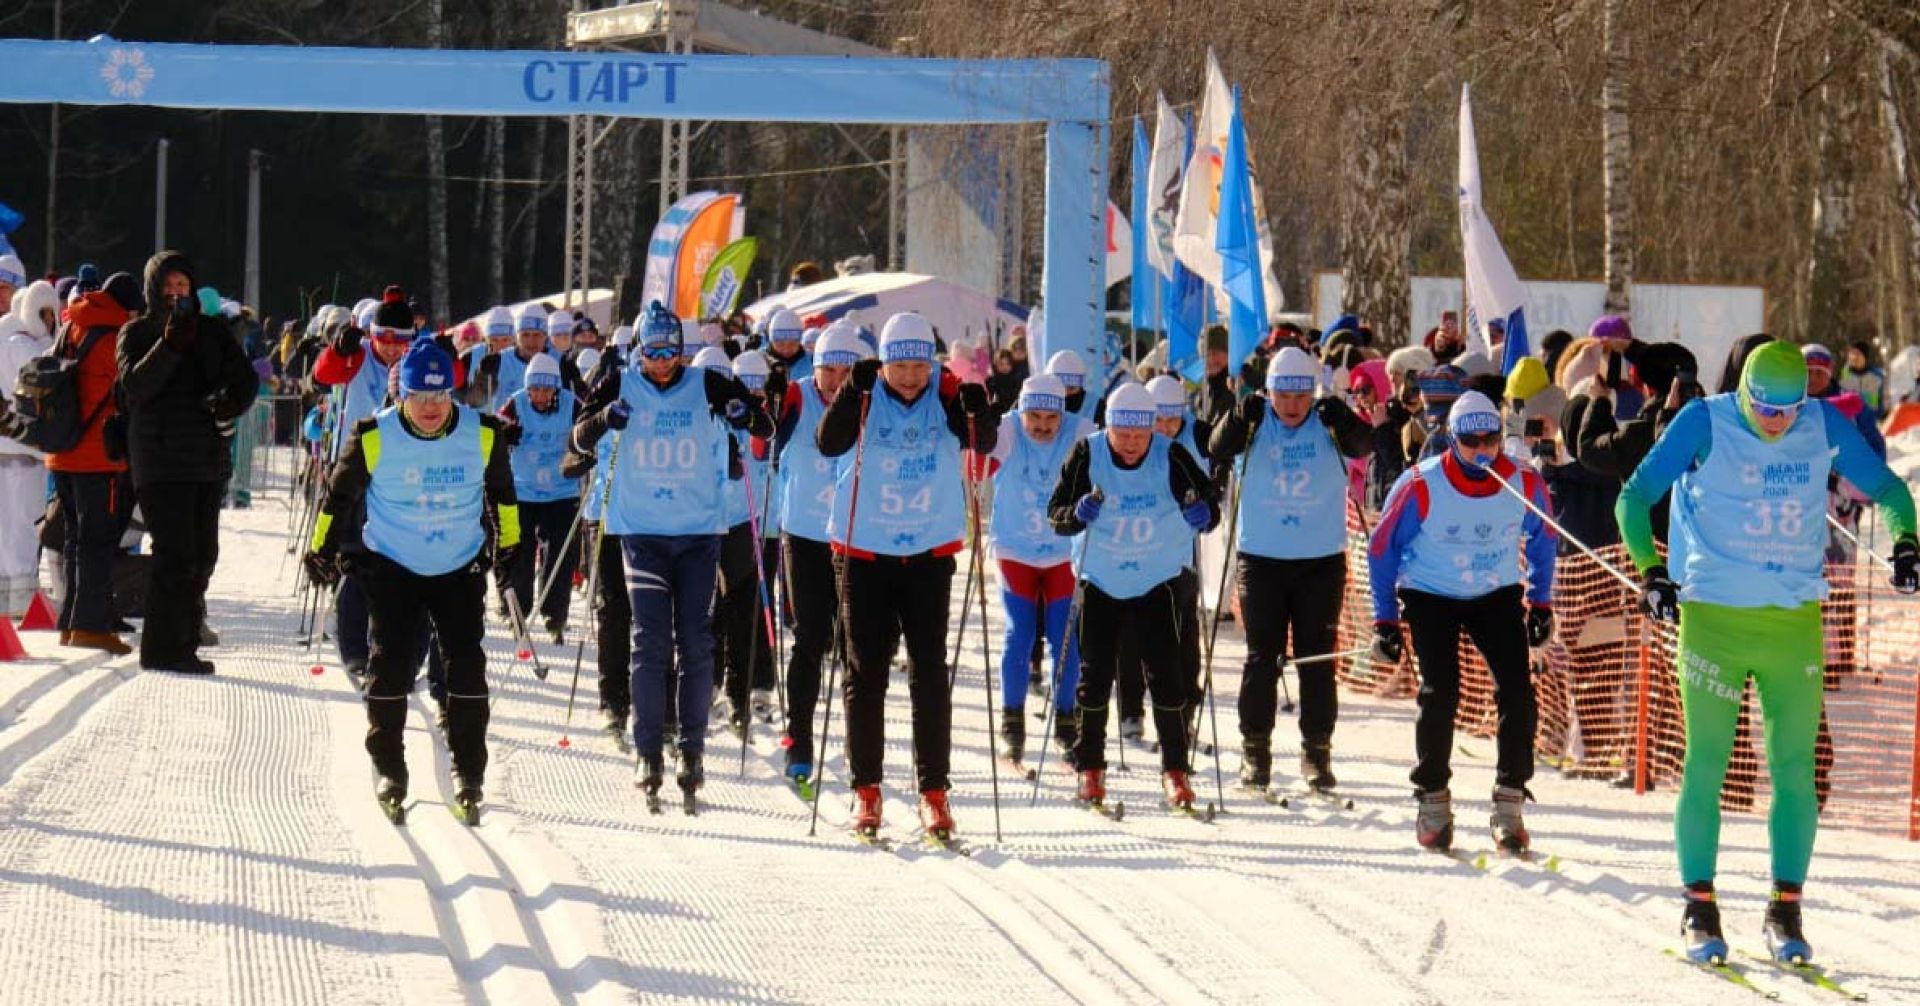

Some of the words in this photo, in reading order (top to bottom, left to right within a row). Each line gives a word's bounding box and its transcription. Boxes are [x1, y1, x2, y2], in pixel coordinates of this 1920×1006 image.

[523, 60, 687, 104] СТАРТ
[632, 438, 697, 469] 100
[815, 483, 834, 506] 4
[1273, 470, 1312, 497] 12
[880, 483, 932, 514] 54
[1025, 511, 1043, 534] 3
[1112, 516, 1153, 544] 70
[1744, 499, 1803, 538] 38
[1706, 679, 1743, 702] TEAM
